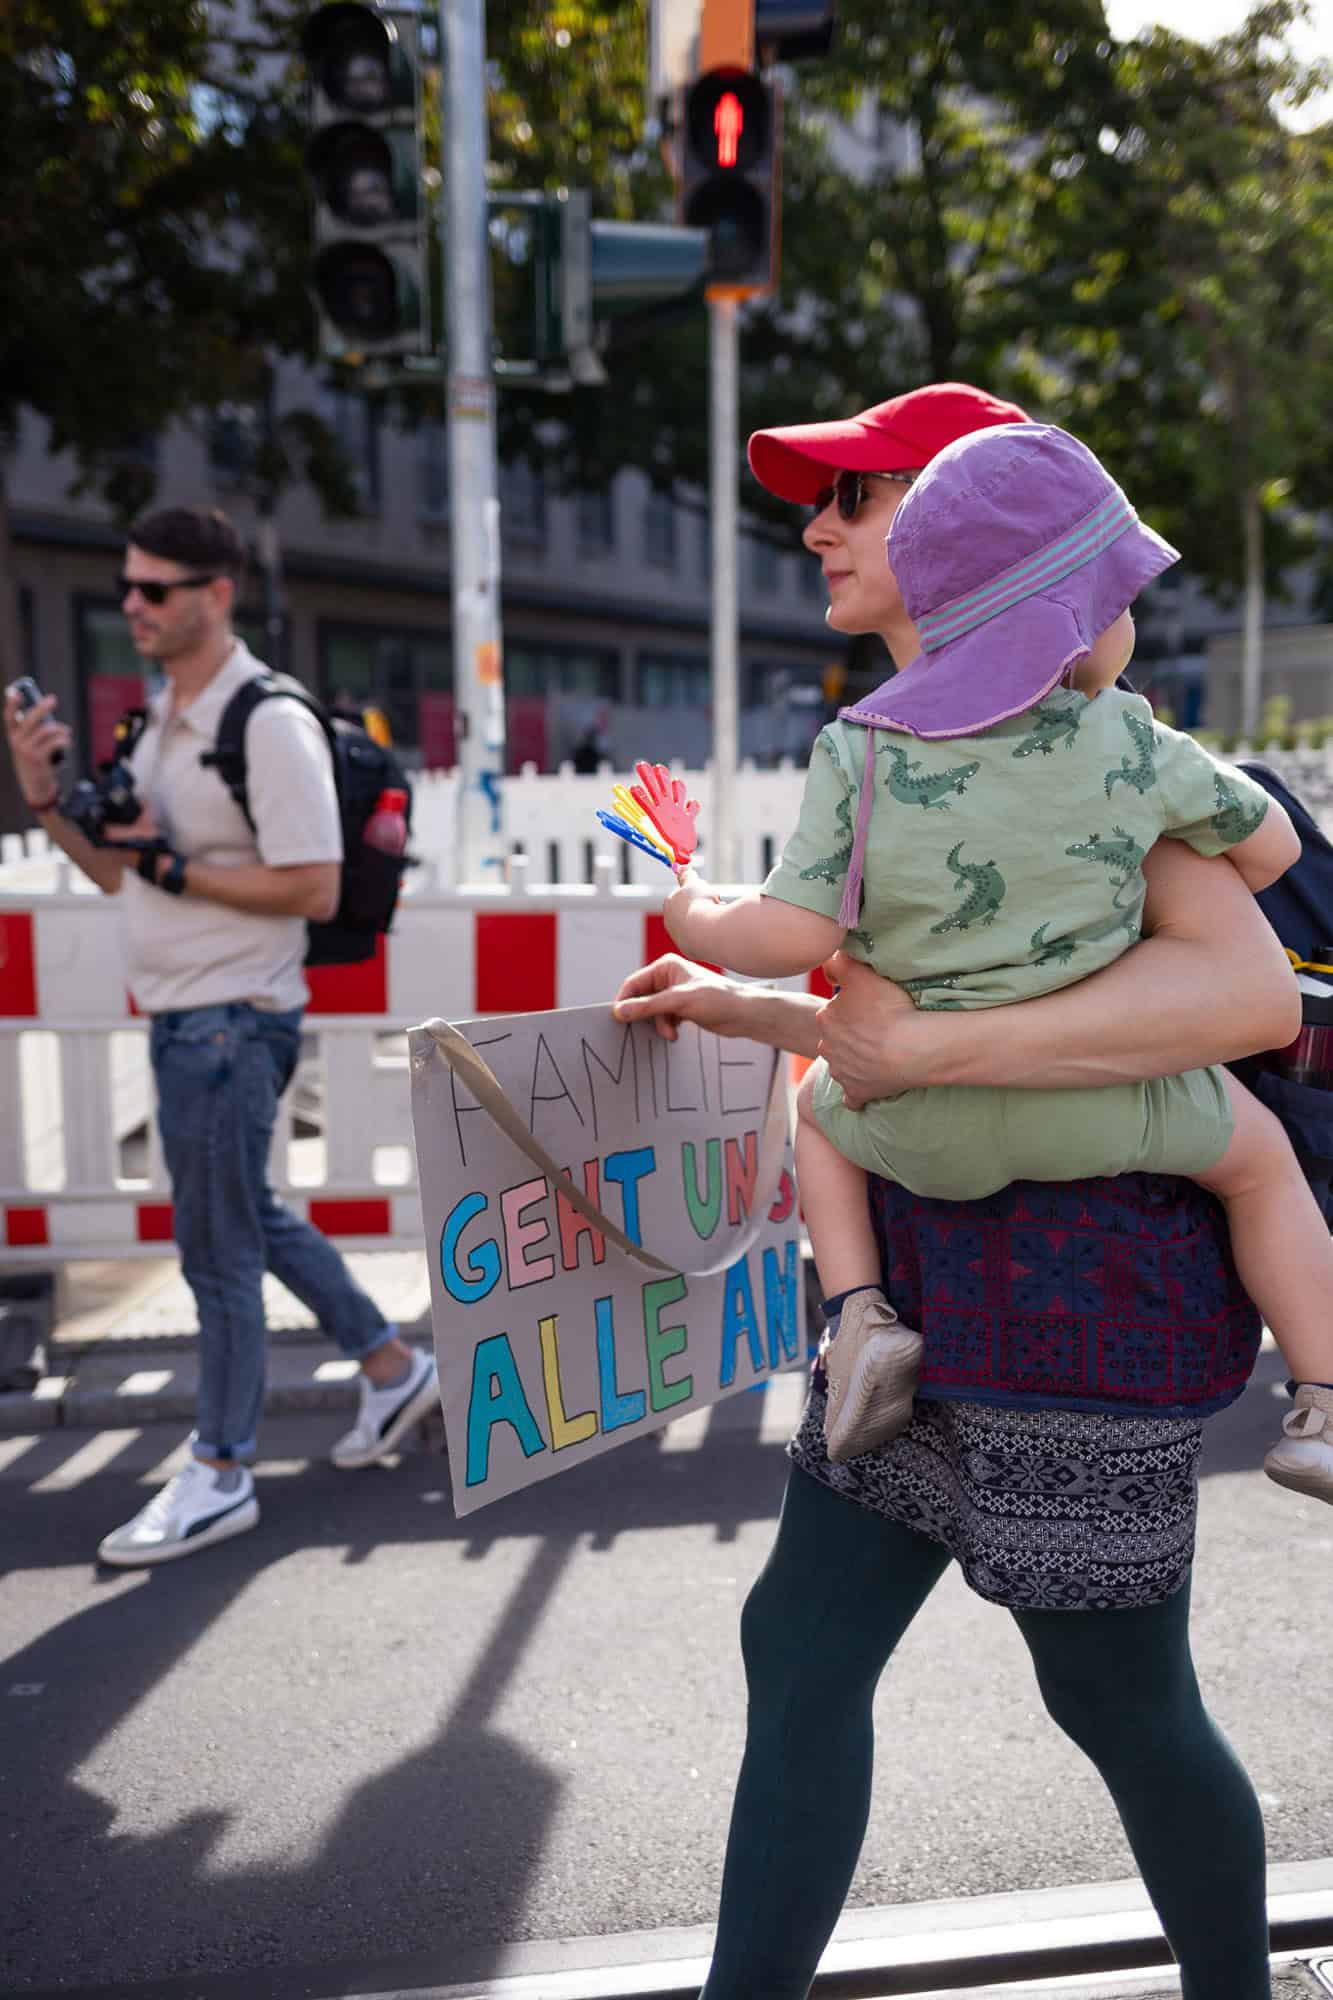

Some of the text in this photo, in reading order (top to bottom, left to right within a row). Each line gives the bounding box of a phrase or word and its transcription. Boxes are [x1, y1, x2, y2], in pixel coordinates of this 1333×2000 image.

[449, 1022, 761, 1168] FAMILIE
[441, 1146, 656, 1303] GEHT
[465, 1240, 797, 1487] ALLE AN
